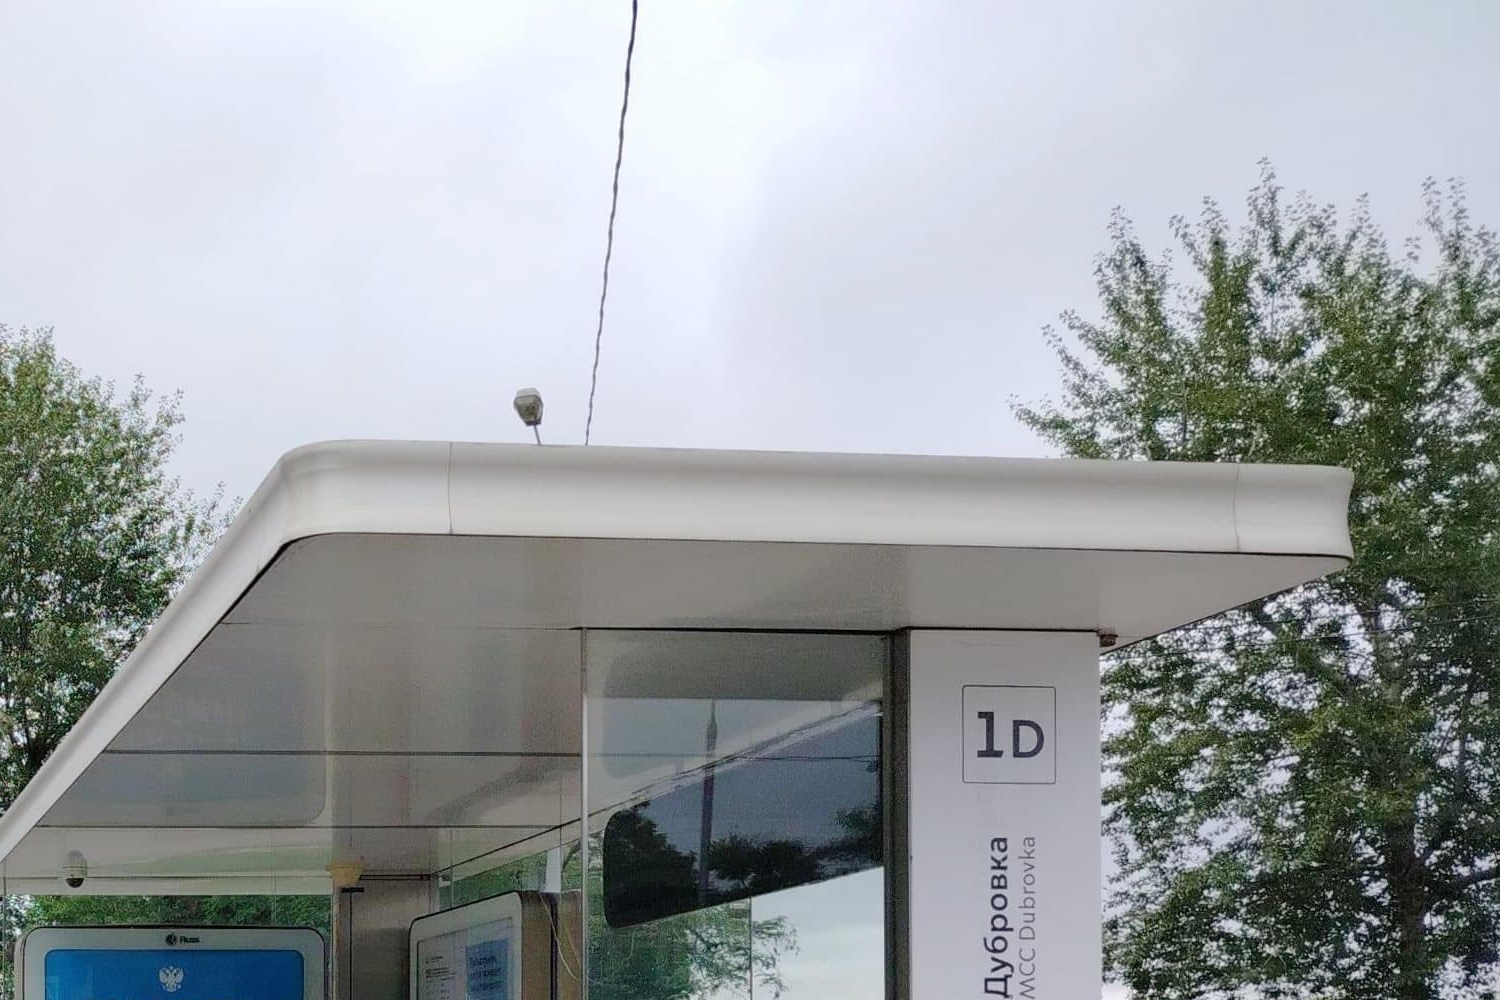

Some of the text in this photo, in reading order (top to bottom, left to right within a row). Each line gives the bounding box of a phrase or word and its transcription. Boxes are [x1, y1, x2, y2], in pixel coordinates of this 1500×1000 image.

[976, 711, 1045, 758] 1D
[983, 836, 1014, 999] Дубровка
[1018, 836, 1036, 1000] MCC Dubrovka
